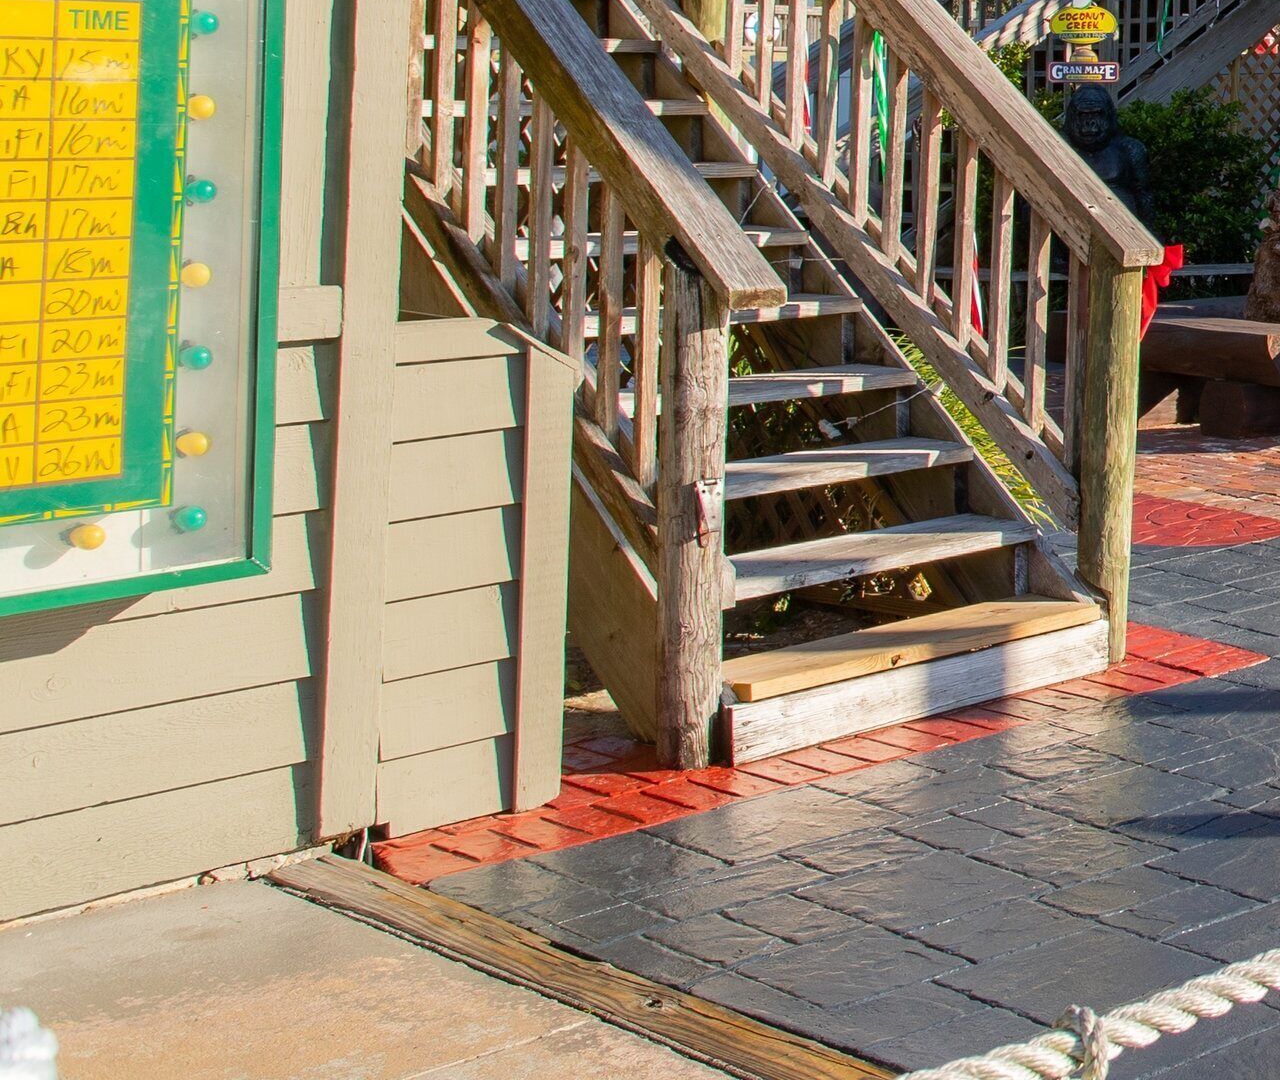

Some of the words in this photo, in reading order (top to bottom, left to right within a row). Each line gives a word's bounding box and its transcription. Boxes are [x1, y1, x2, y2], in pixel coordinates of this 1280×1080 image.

[68, 9, 130, 31] TIME
[1058, 12, 1106, 21] COCONUT
[1066, 21, 1099, 30] CREEK
[1051, 64, 1083, 79] GRAN
[1084, 64, 1116, 80] MAZE
